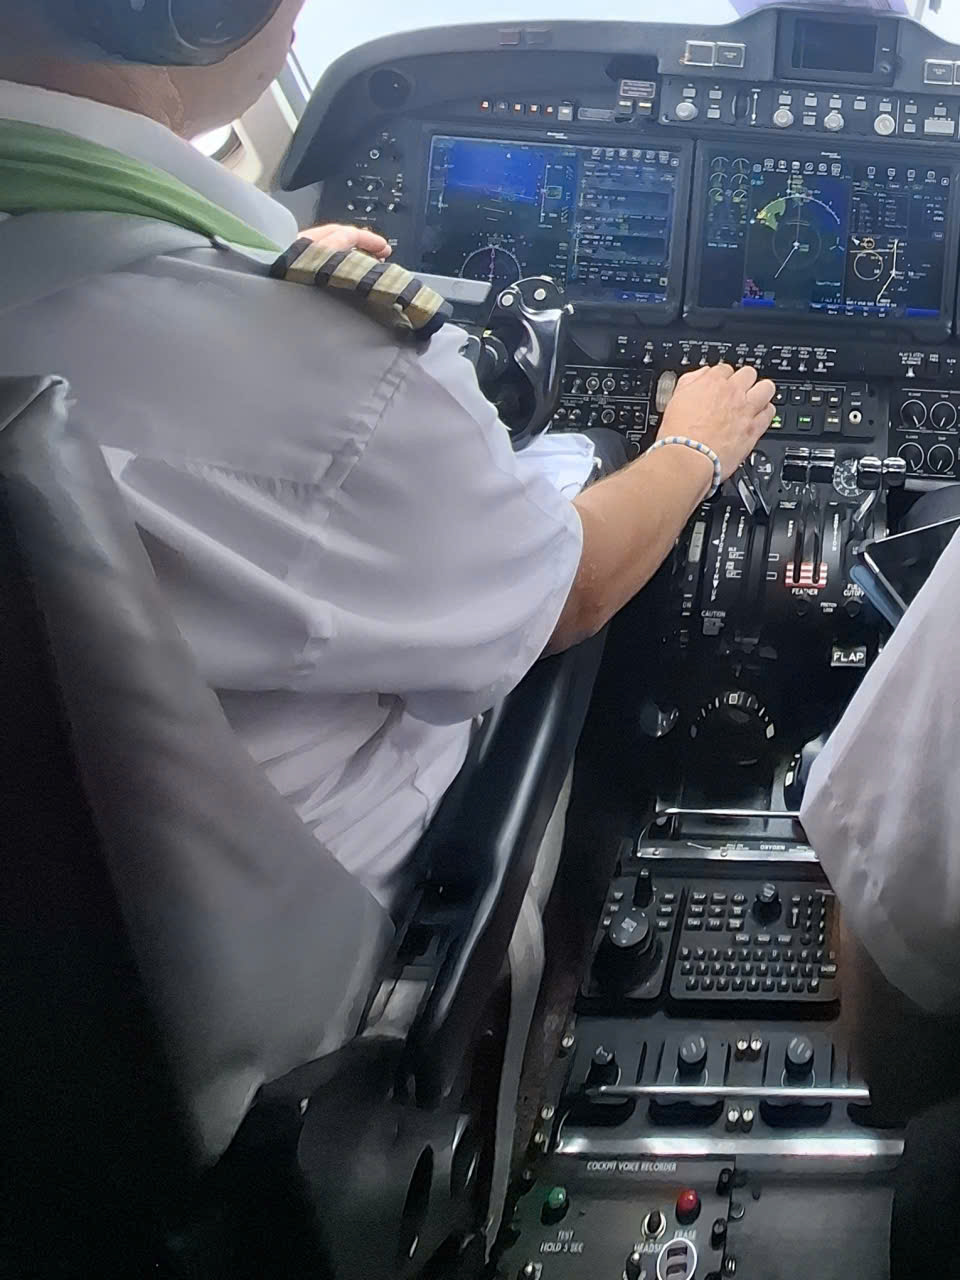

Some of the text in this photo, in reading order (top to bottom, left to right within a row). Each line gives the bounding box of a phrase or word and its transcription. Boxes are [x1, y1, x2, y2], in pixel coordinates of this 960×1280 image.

[714, 556, 722, 580] TRIM
[792, 588, 819, 596] FEATHER
[701, 609, 726, 618] CAUTION
[833, 652, 865, 662] FLAP
[586, 1161, 677, 1171] COCKPIT VOICE RECORDER
[558, 1230, 574, 1240] TEST
[674, 1230, 696, 1240] ERASE
[540, 1242, 561, 1253] HOLD
[571, 1242, 585, 1253] SEC
[634, 1242, 664, 1253] HEADSE
